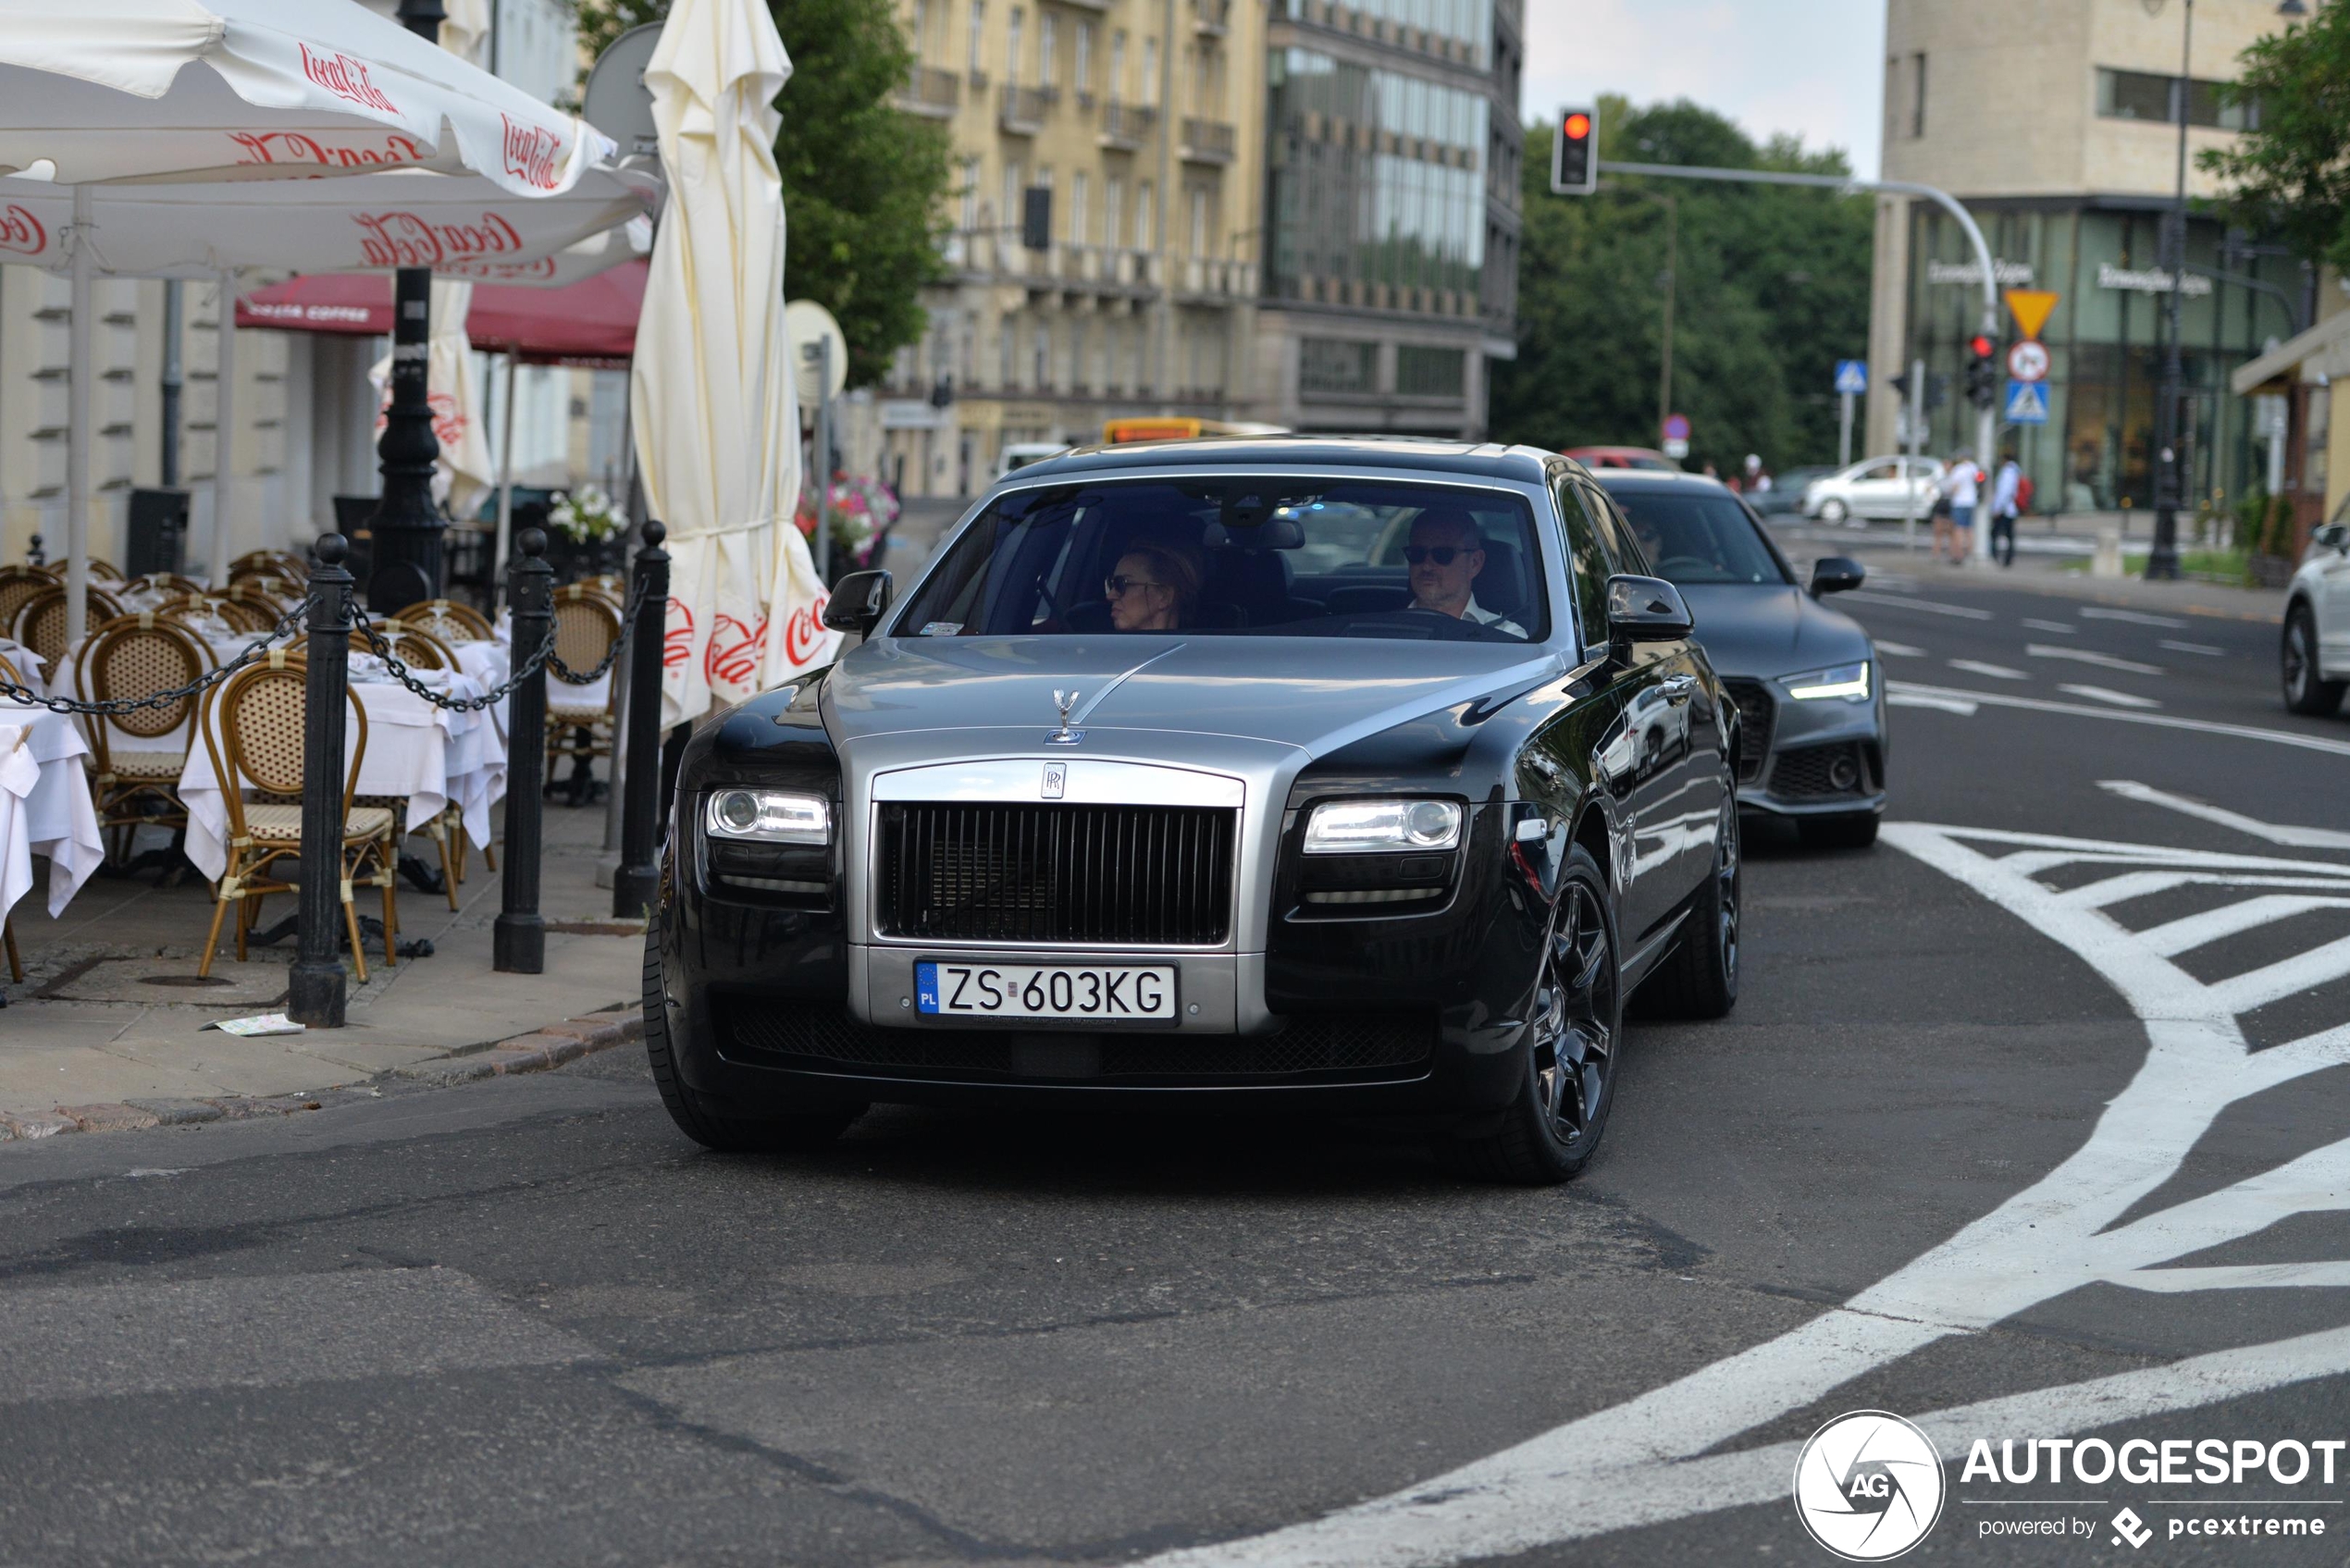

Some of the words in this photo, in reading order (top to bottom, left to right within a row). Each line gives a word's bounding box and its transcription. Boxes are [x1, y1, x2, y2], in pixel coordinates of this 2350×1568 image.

[921, 994, 936, 1005] PL
[947, 969, 1002, 1010] ZS
[1023, 970, 1161, 1013] 603KG
